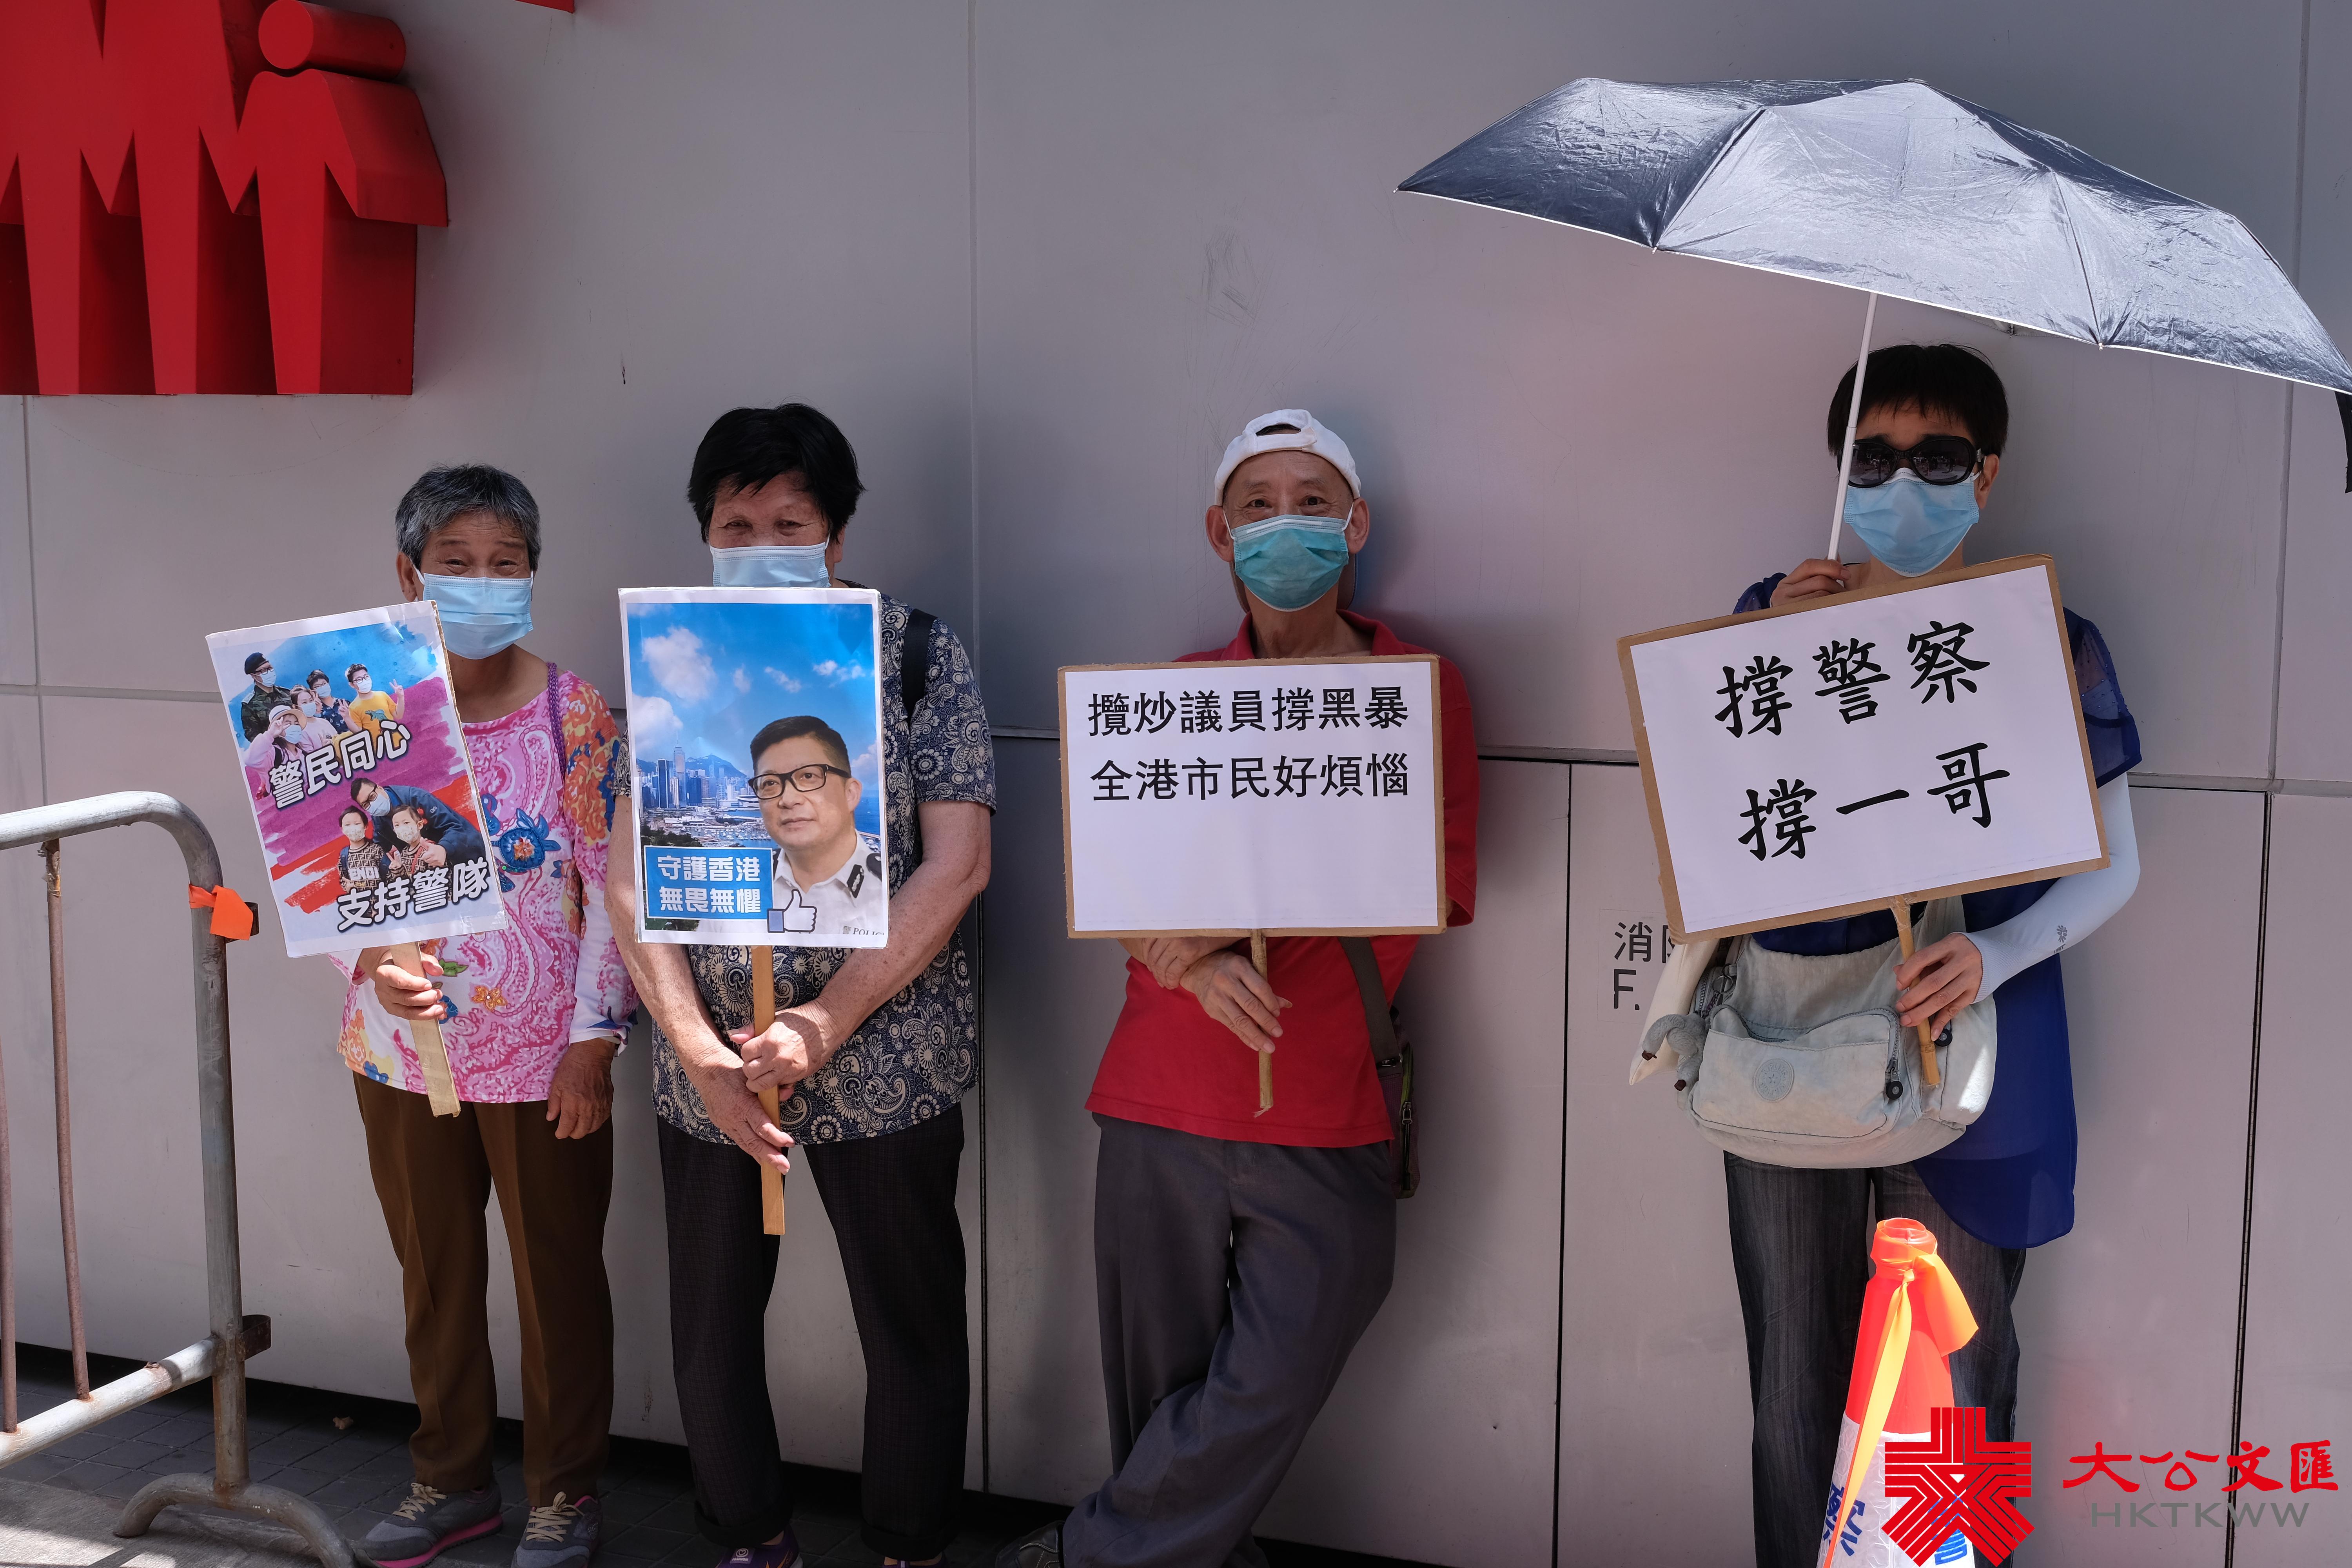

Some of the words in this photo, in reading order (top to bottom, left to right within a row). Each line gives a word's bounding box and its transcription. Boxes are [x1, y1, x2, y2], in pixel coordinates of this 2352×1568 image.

[1714, 620, 1991, 738] 撐警察
[1088, 687, 1409, 737] 攬炒議員撐黑暴
[269, 720, 411, 809] 警民同心
[1090, 752, 1409, 802] 全港市民好煩惱
[1738, 742, 2011, 862] 撐一哥
[338, 857, 488, 931] 支持警隊
[657, 855, 760, 882] 守護香港
[659, 886, 761, 913] 無畏無懼
